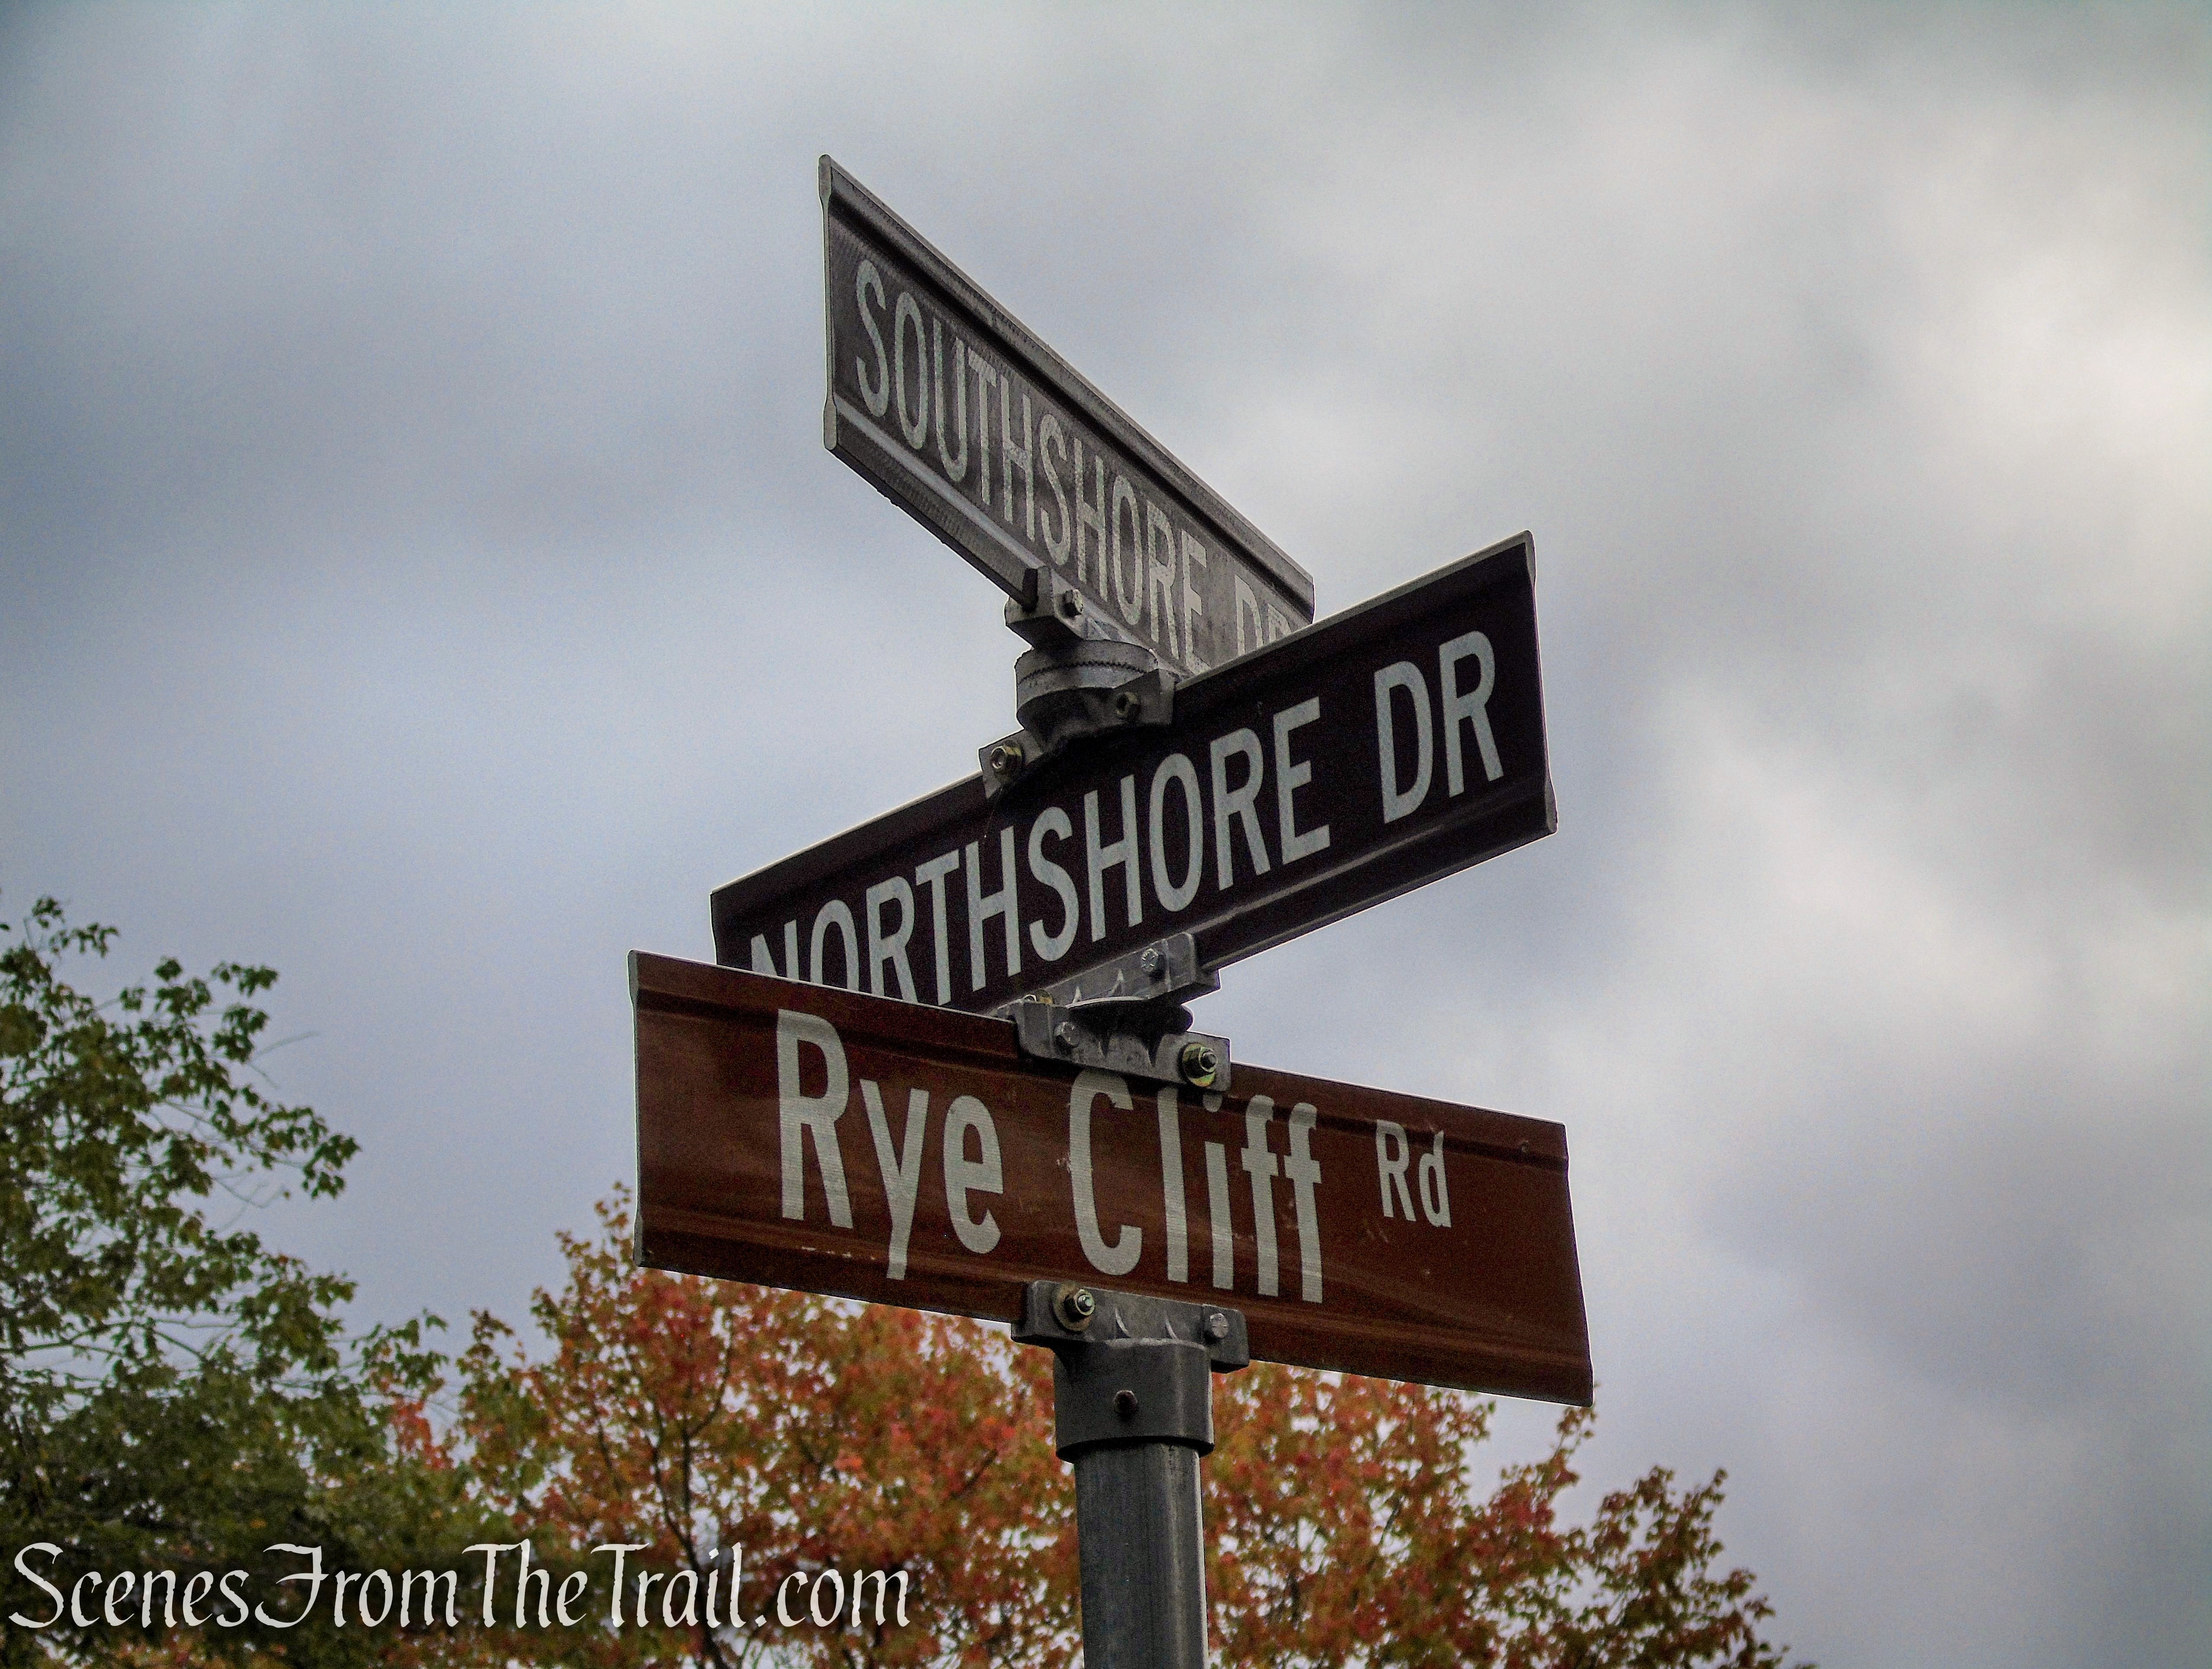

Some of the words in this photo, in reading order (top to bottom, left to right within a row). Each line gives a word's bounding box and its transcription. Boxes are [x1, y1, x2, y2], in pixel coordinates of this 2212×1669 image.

[856, 260, 1211, 675] SOUTHSHORE
[1374, 630, 1503, 823] DR
[777, 1009, 1002, 1280] Rye
[1069, 1069, 1322, 1302] Cliff
[1377, 1119, 1452, 1228] Rd
